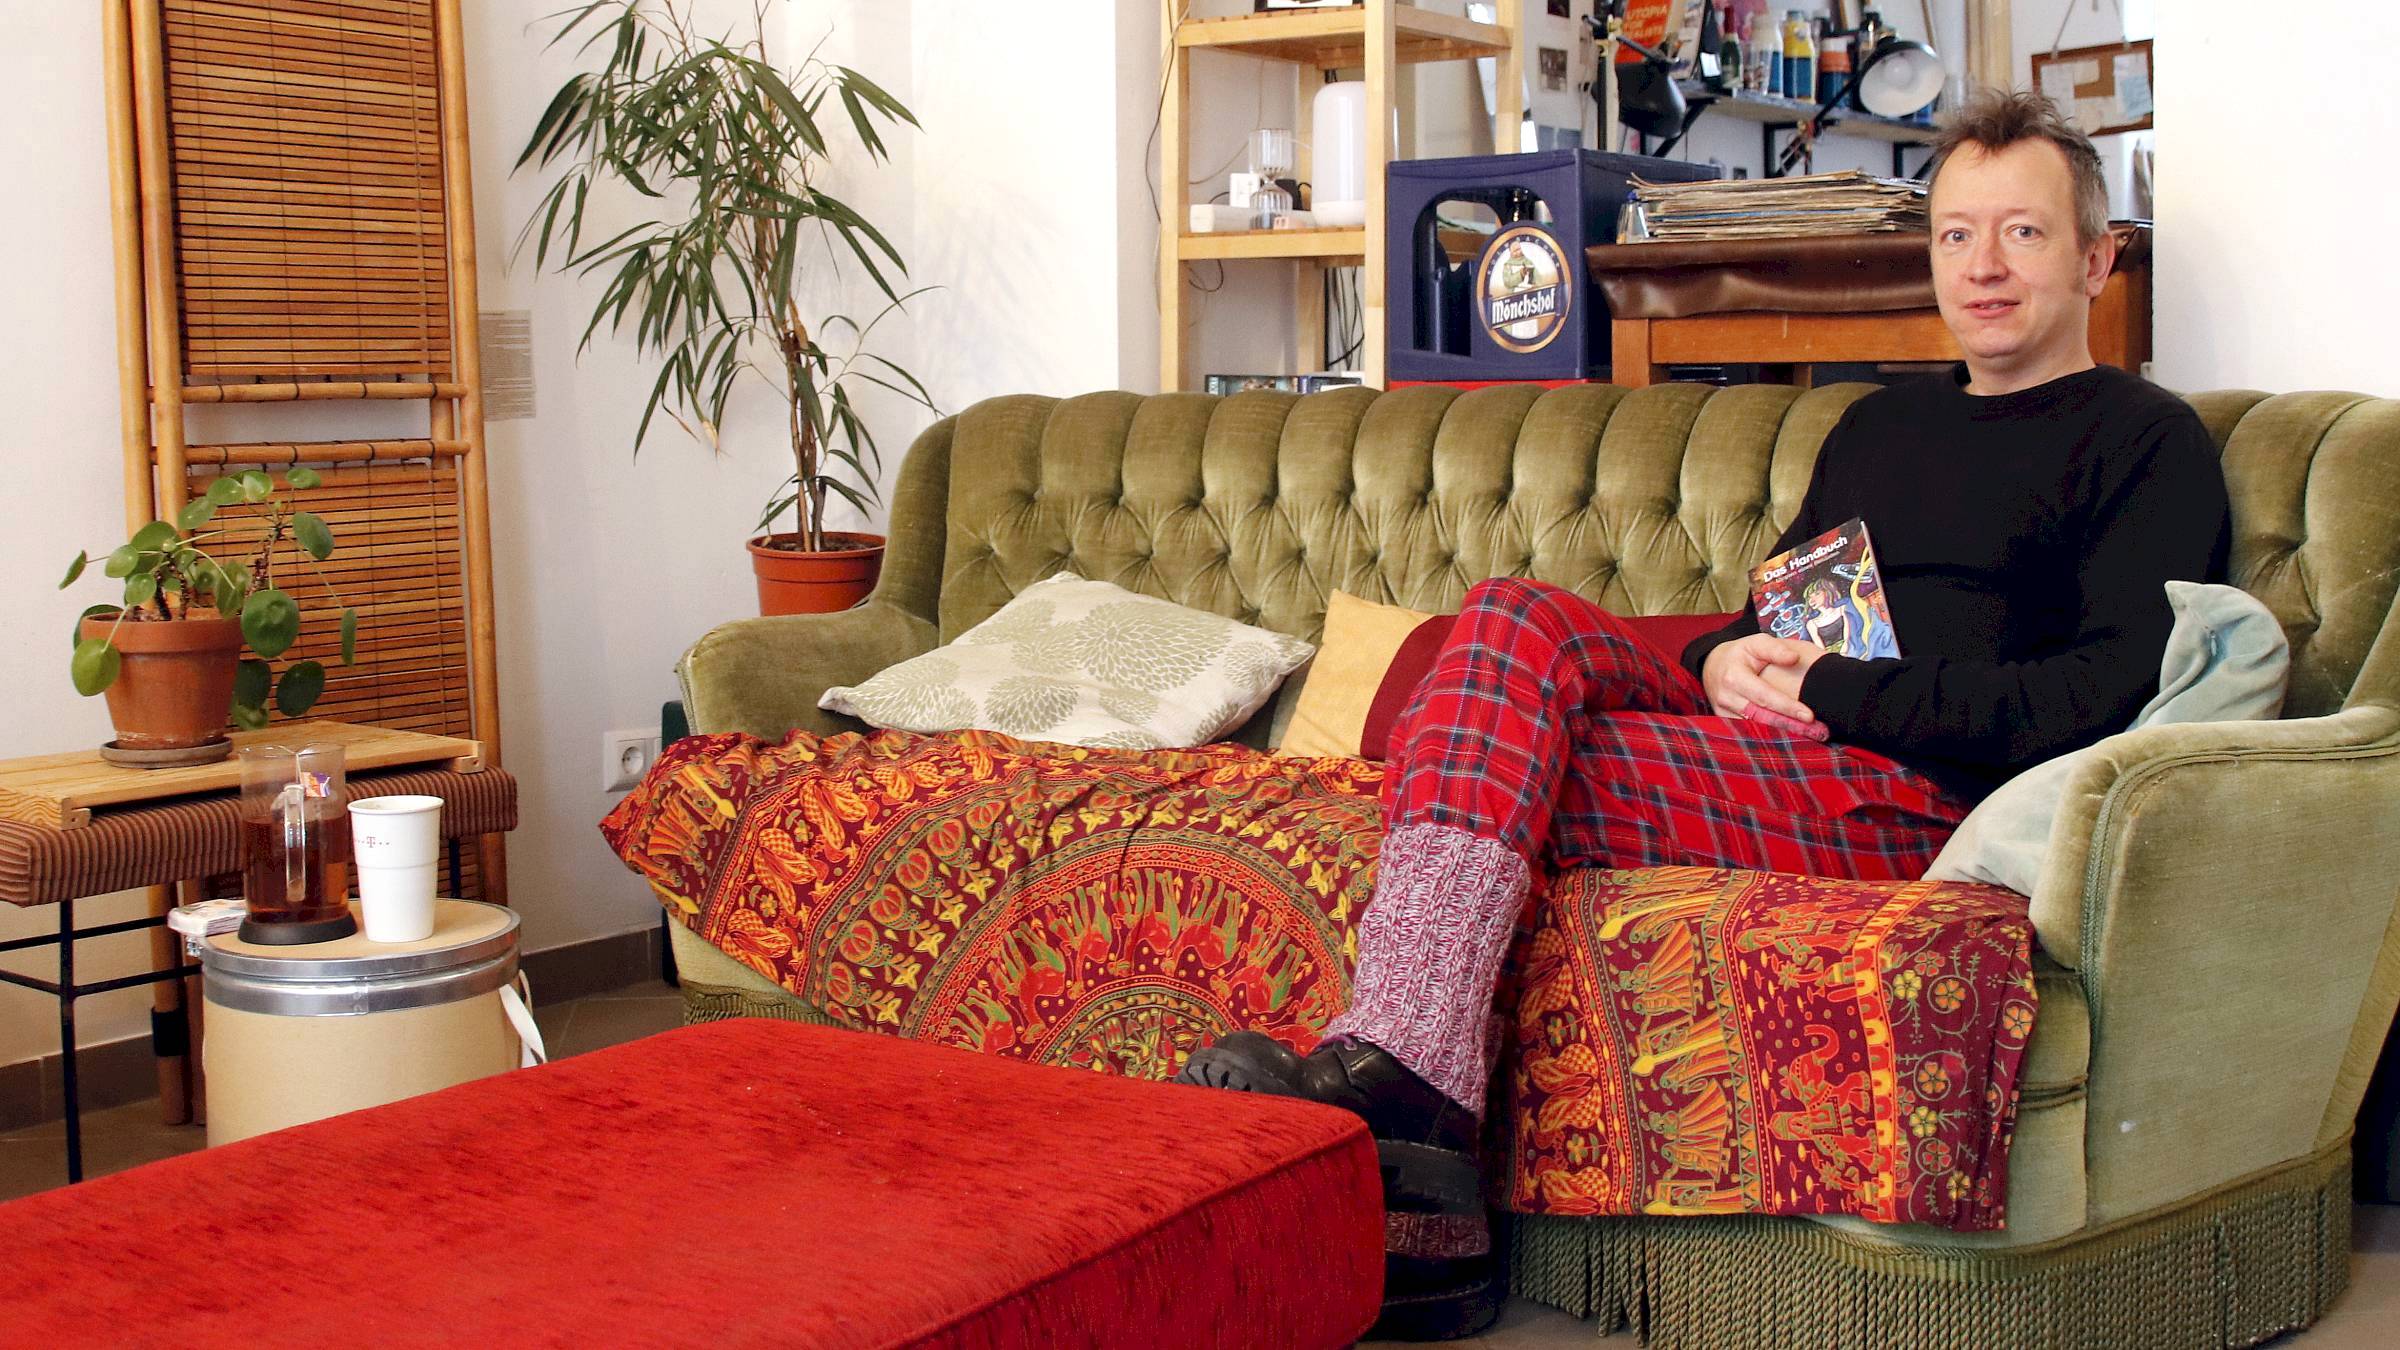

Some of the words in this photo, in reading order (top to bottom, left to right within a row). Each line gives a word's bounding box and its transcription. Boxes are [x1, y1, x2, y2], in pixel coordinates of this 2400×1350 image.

[1627, 5, 1668, 19] UTOPIA
[1492, 287, 1555, 324] Mönchshof
[1764, 565, 1787, 582] Das
[1789, 536, 1848, 570] Handbuch
